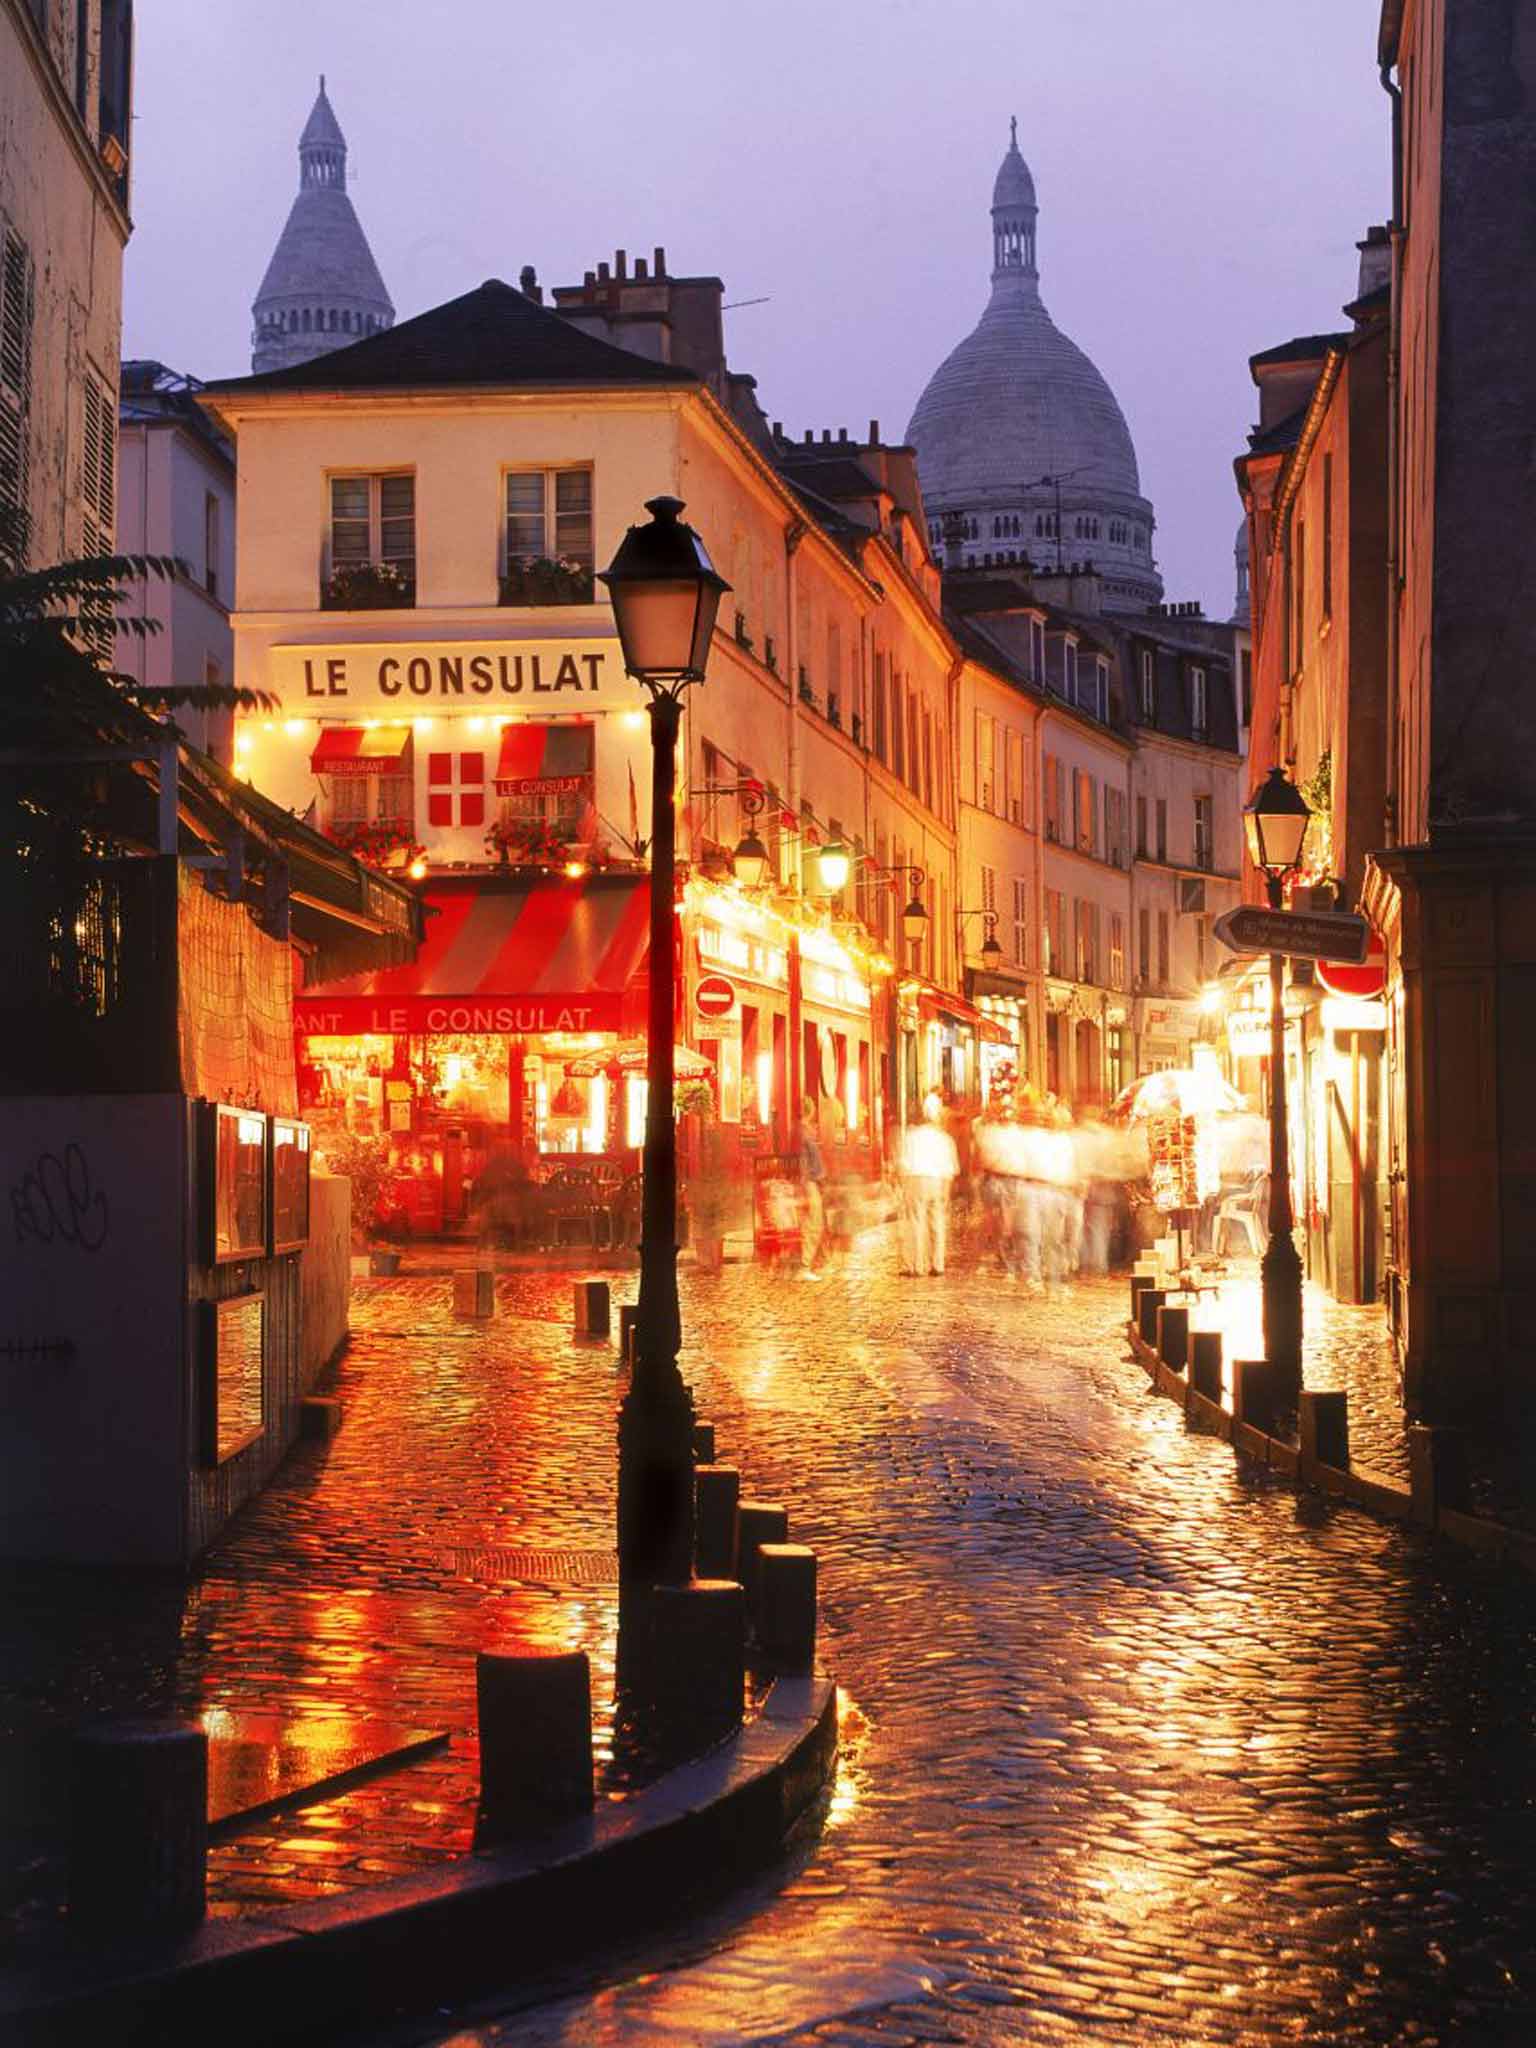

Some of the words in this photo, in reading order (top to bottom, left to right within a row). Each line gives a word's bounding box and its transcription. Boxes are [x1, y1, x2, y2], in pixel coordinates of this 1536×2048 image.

[305, 660, 348, 696] LE
[378, 654, 605, 696] CONSULAT
[324, 761, 385, 772] RESTAURANT
[501, 783, 514, 795] LE
[520, 777, 581, 794] CONSULAT
[371, 1010, 407, 1032] LE
[426, 1007, 592, 1032] CONSULAT
